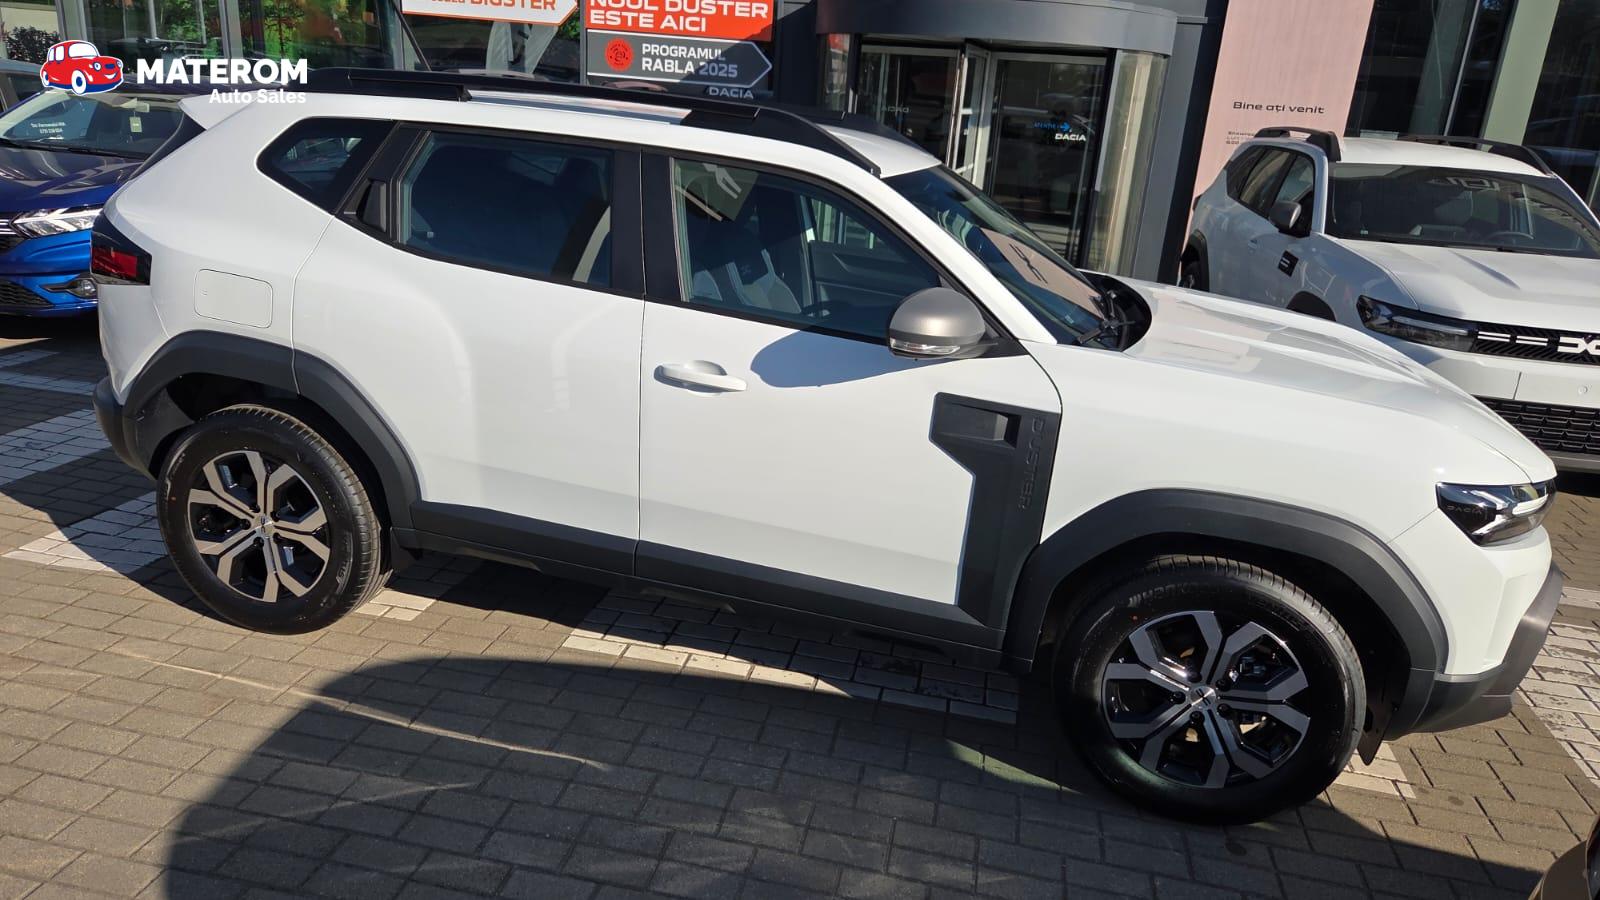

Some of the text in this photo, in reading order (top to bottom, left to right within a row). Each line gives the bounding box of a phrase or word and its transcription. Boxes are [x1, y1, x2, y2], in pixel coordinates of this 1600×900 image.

[665, 0, 768, 18] DUSTER
[590, 10, 706, 32] ESTE AICI
[642, 43, 726, 61] PROGRAMUL
[642, 57, 738, 78] RABLA 2025
[708, 86, 754, 99] DACIA
[1233, 101, 1263, 110] Bine
[1289, 105, 1325, 113] venit
[1055, 133, 1086, 141] DACIA
